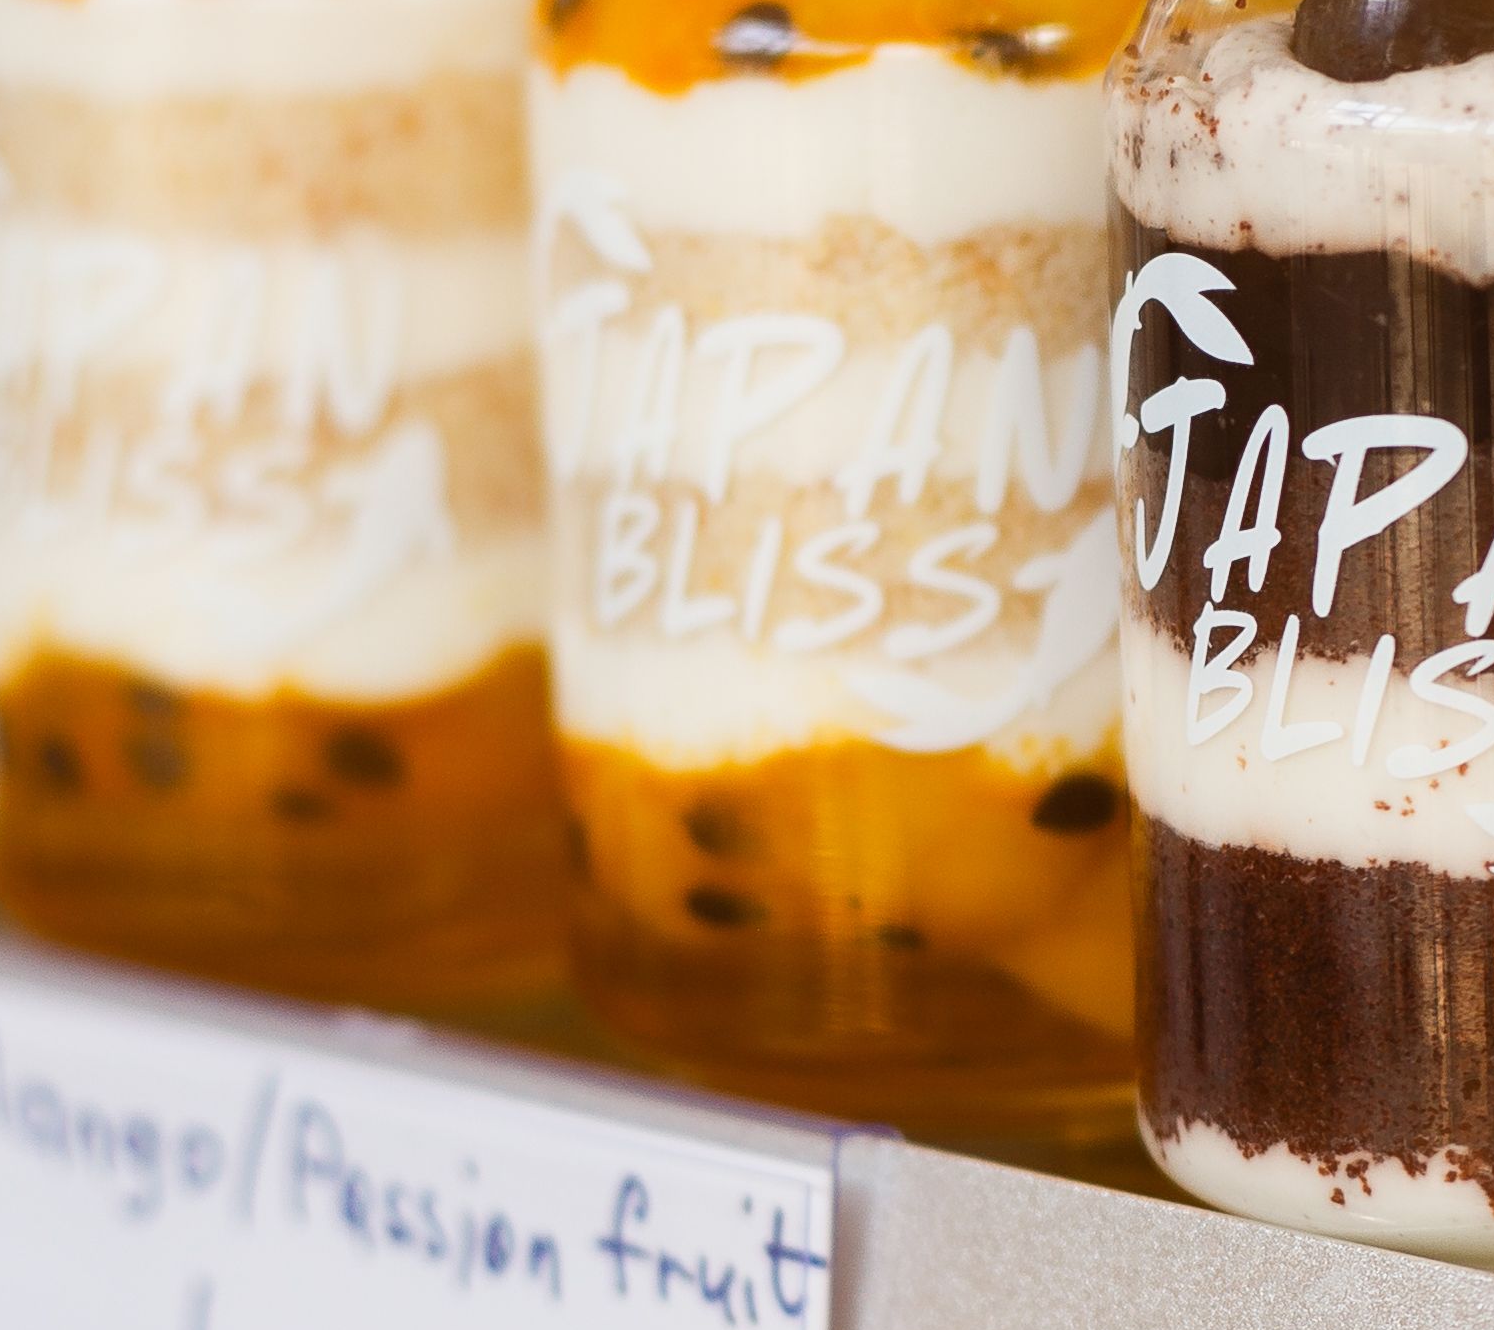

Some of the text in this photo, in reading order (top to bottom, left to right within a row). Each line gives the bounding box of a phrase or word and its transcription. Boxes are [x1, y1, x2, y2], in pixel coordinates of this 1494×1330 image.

[546, 285, 1100, 521] JAPAN
[596, 494, 1002, 659] BLISS
[594, 1173, 831, 1327] fruit
